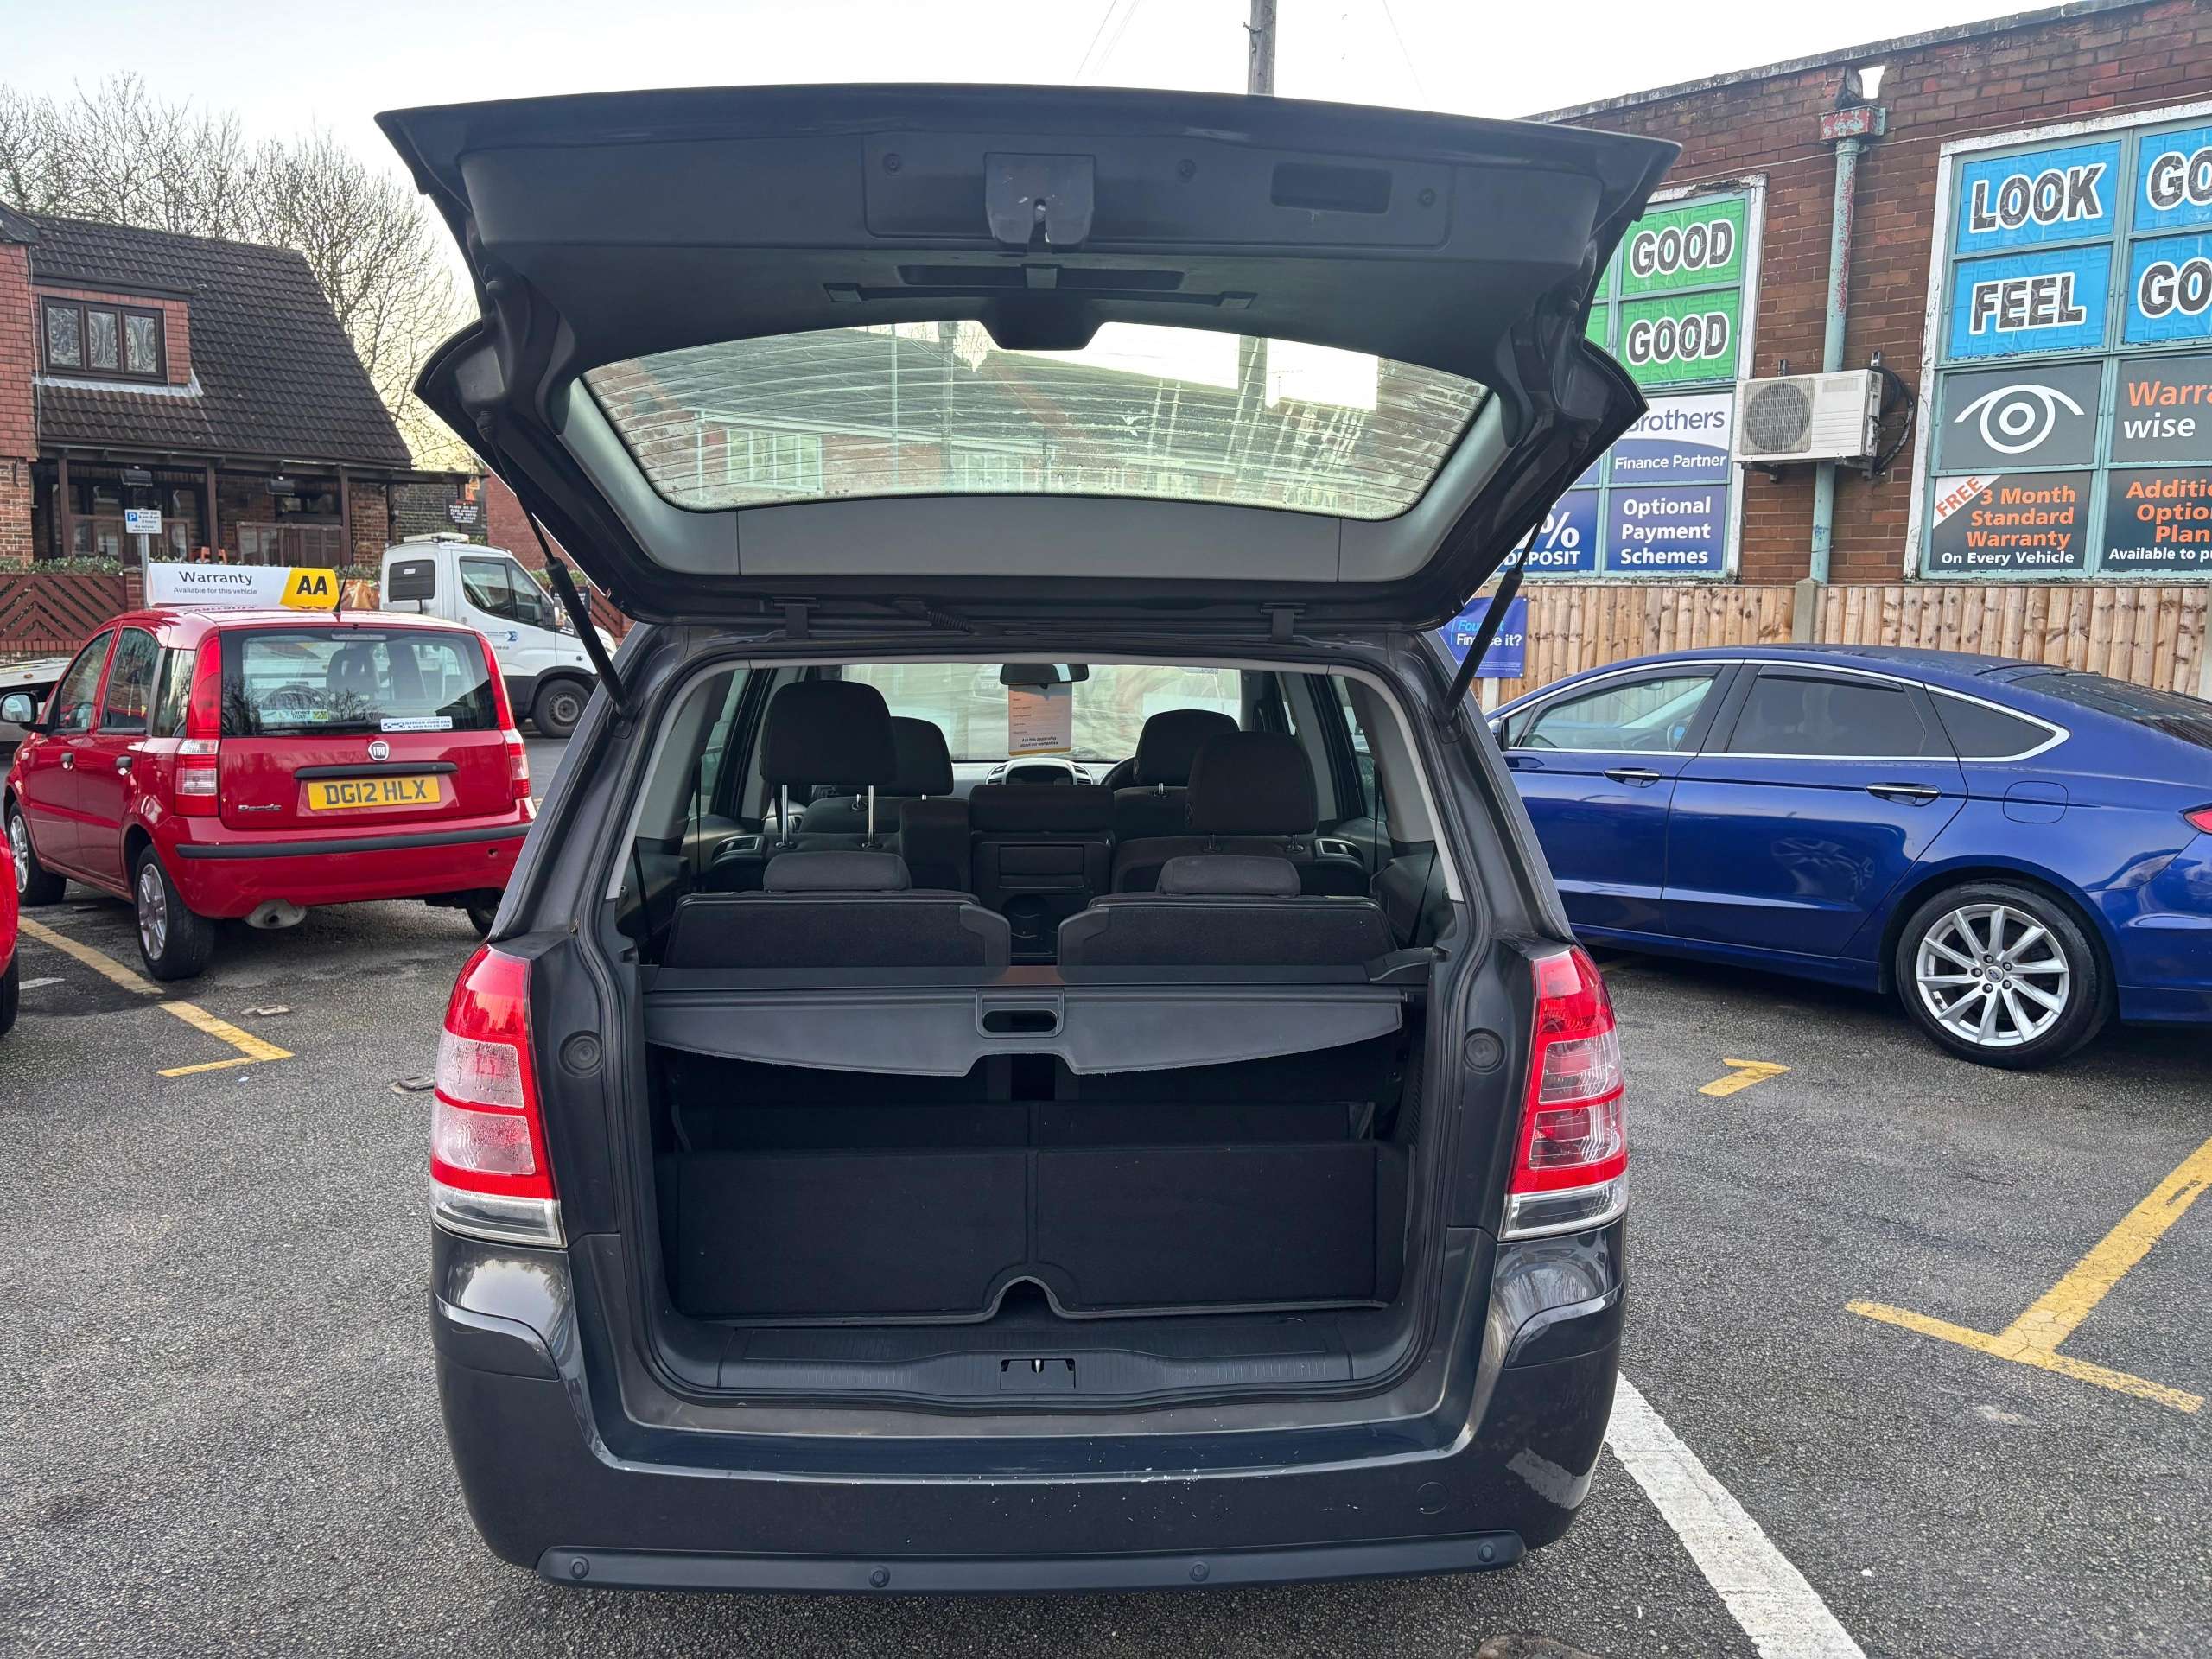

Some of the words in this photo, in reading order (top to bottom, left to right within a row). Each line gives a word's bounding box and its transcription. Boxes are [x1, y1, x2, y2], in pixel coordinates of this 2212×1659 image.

[1969, 162, 2107, 234] LOOK
[1630, 219, 1735, 278] GOOD
[1969, 272, 2087, 334] FEEL
[1626, 311, 1730, 365] GOOD
[2123, 412, 2196, 439] wise
[1614, 456, 1669, 470] Finance
[1673, 454, 1727, 467] Partner
[1936, 476, 1984, 518] FREE
[1980, 487, 1993, 505] 3
[2000, 485, 2075, 505] Month
[1623, 495, 1711, 519] Optional
[1970, 506, 2075, 527] Standard
[2136, 502, 2212, 525] Optio
[1621, 523, 1712, 544] Payment
[1967, 530, 2071, 550] Warranty
[1620, 547, 1709, 565] Schemes
[1941, 552, 1962, 564] On
[1967, 552, 2012, 566] Every
[2016, 550, 2075, 563] Vehicle
[2108, 547, 2176, 560] Available
[2180, 548, 2196, 560] to
[178, 570, 253, 586] Warranty
[296, 575, 328, 596] AA
[1504, 633, 1522, 646] it?
[323, 782, 378, 804] DG12
[384, 779, 428, 800] HLX
